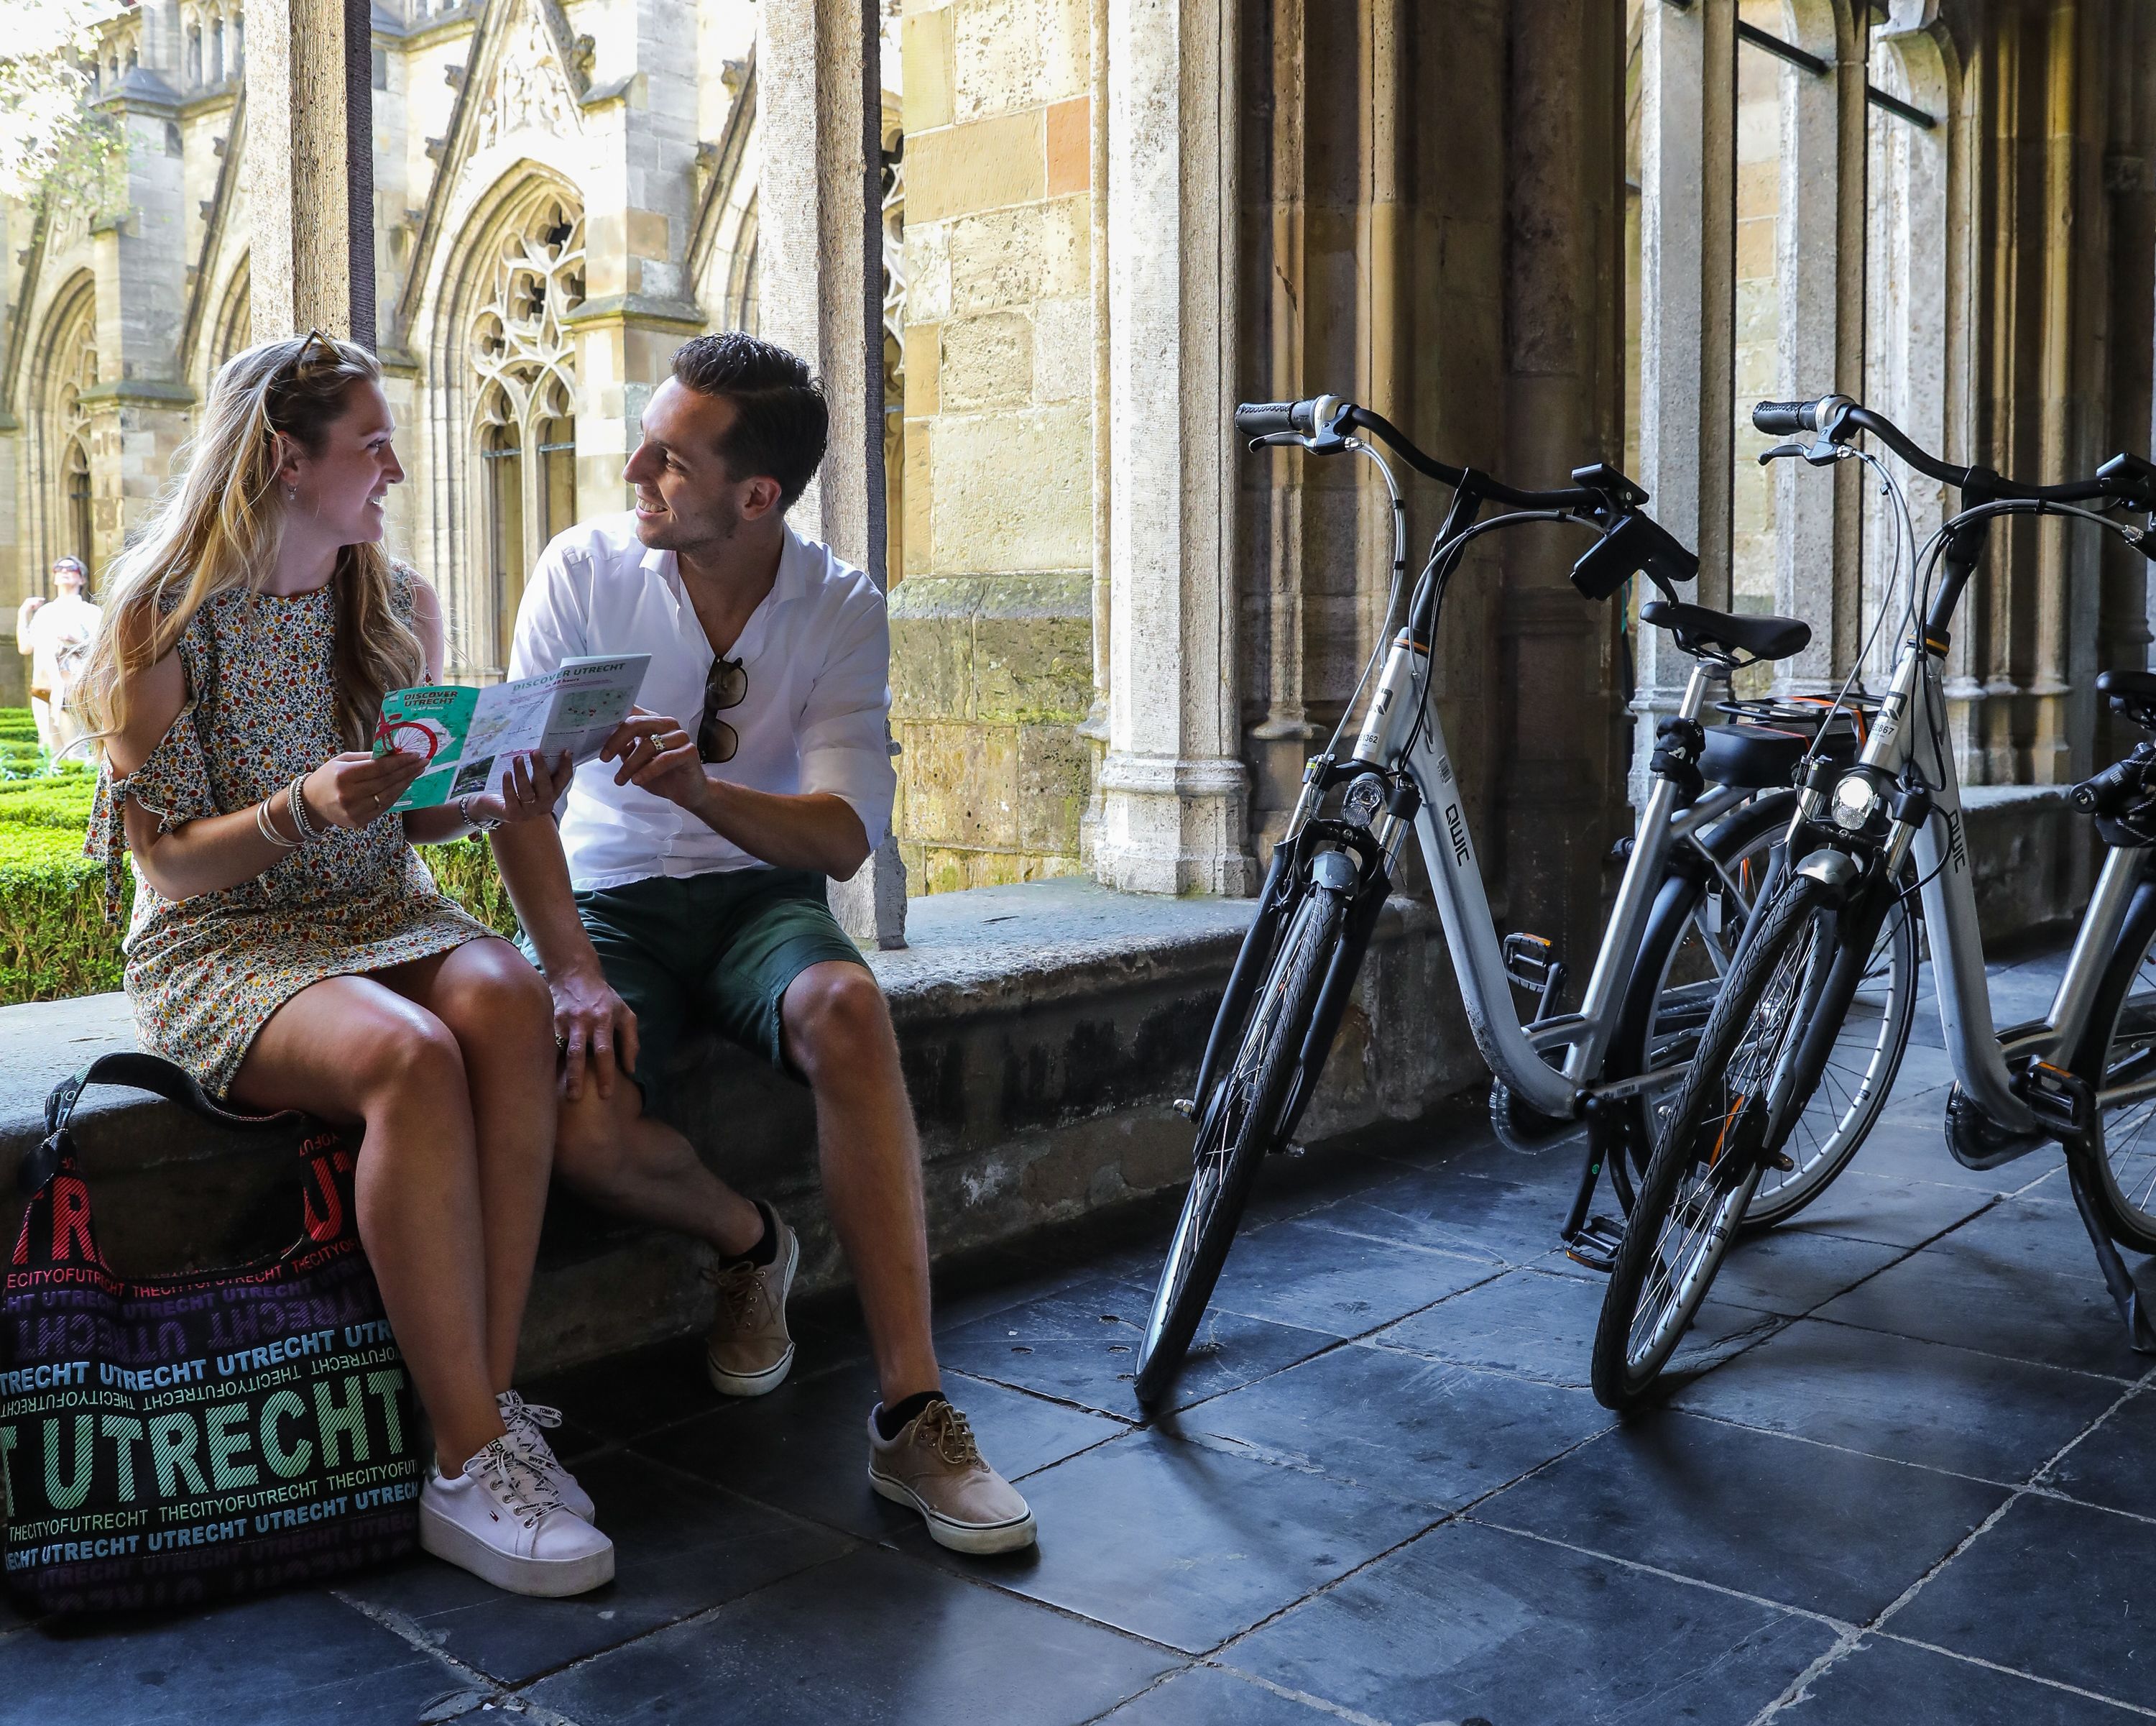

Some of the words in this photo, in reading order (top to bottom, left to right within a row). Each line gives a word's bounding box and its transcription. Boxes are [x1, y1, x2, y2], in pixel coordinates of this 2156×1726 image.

[404, 691, 459, 701] DISCOVER
[513, 670, 571, 692] DISCOVER
[573, 663, 626, 676] UTRECHT
[404, 697, 454, 707] UTRECHT
[1445, 803, 1470, 868] QWIC
[1948, 809, 1966, 874] QWIC
[122, 1292, 215, 1321] UTRECHT
[221, 1277, 312, 1303] UTRECHT
[99, 1358, 207, 1392] UTRECHT
[216, 1329, 335, 1377] UTRECHT
[310, 1346, 400, 1376] OFUTRECHT
[0, 1390, 137, 1418] THECITYOFUTRECHT
[143, 1365, 302, 1412] THECITYOFUTRECHT
[42, 1368, 403, 1510] UTRECHT
[9, 1510, 149, 1543] THECITYOFUTRECHT
[158, 1480, 318, 1524] THECITYOFUTRECHT
[41, 1535, 141, 1565] UTRECHT
[148, 1518, 248, 1551] UTRECHT
[255, 1496, 349, 1533] UTRECHT
